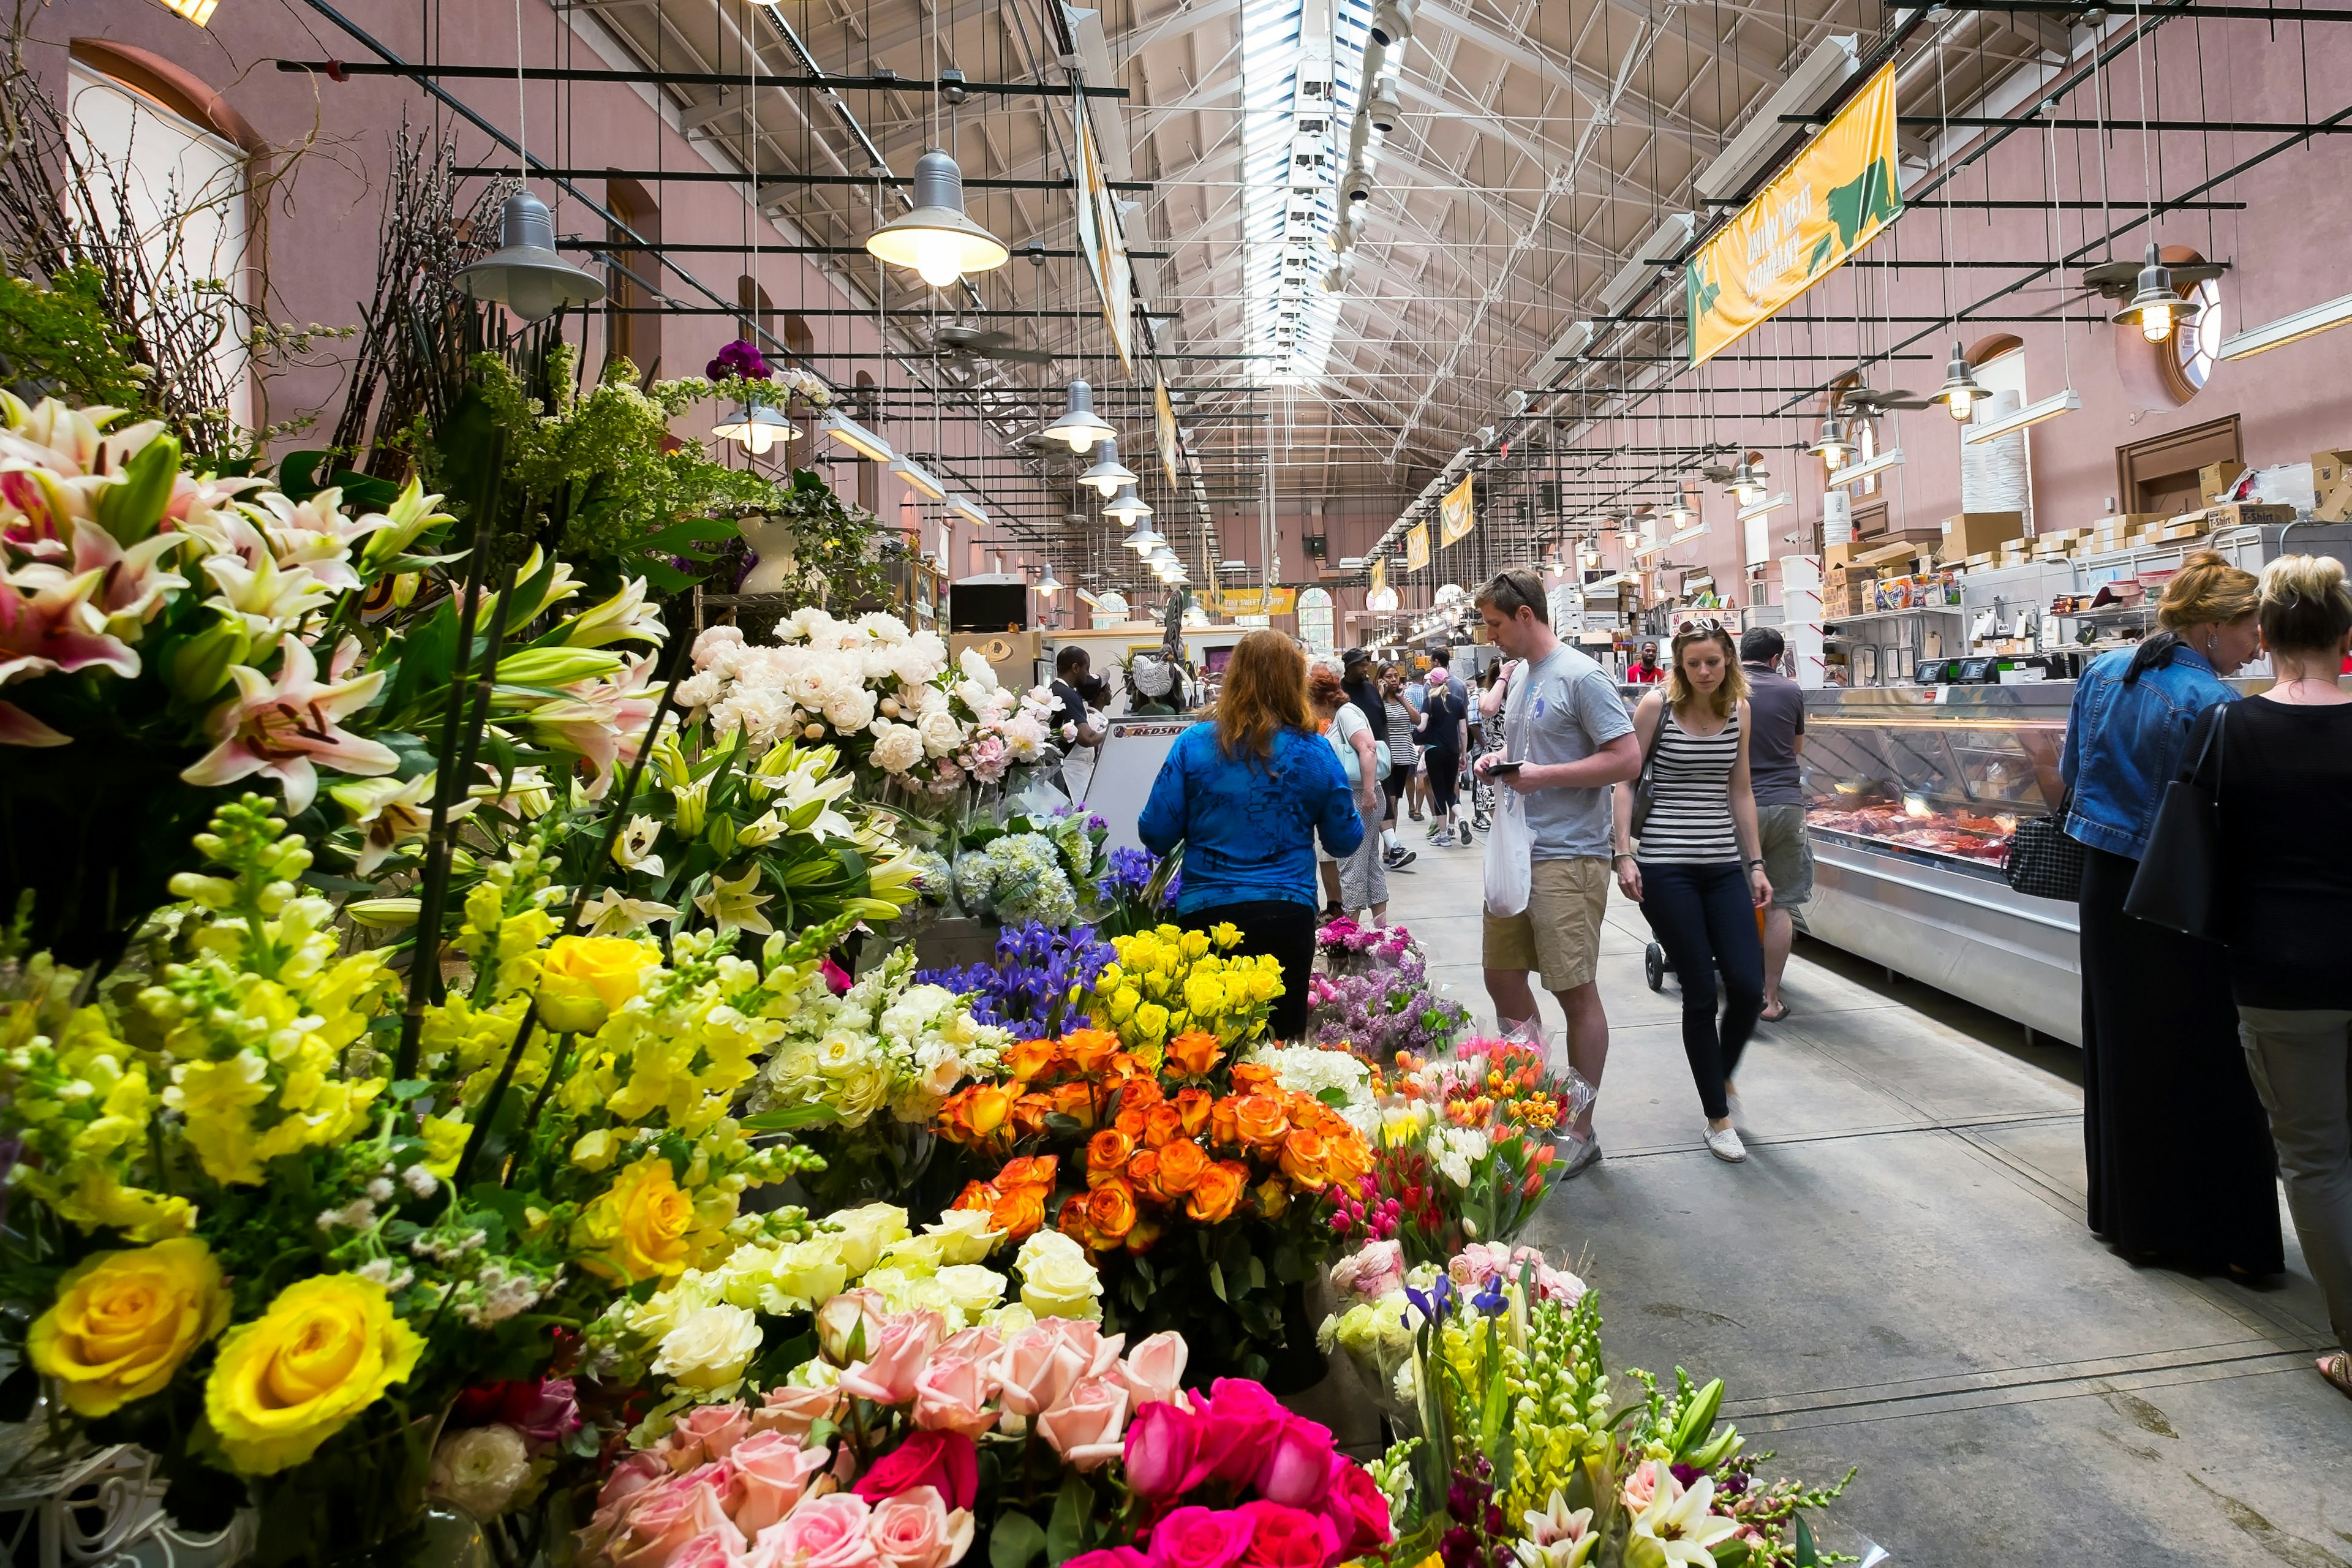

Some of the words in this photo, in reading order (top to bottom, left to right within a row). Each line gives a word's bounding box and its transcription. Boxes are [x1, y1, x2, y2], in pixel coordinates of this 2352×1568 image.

[1781, 183, 1812, 236] MEAT
[1746, 231, 1800, 298] COMPANY
[2209, 516, 2231, 527] T-Shirt
[2241, 513, 2274, 524] T-Shirt
